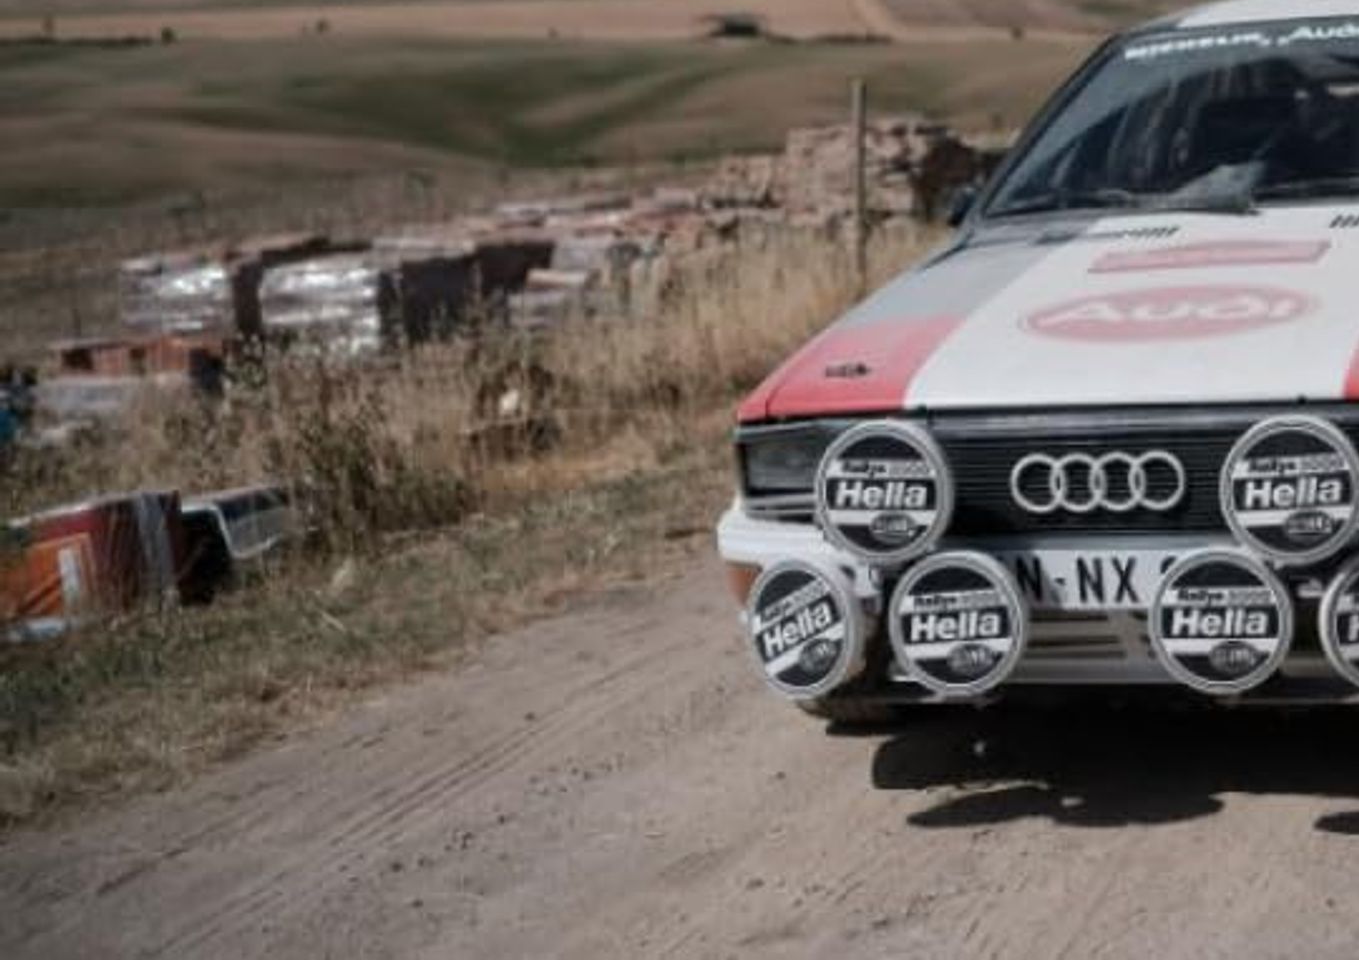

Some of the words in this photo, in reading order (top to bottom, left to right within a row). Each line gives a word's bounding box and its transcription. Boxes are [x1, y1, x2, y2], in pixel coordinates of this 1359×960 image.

[1035, 292, 1298, 327] Audi
[834, 480, 928, 509] Hella
[1244, 476, 1343, 509] Hella
[1014, 555, 1139, 604] N-NX
[762, 600, 832, 659] Hella
[910, 610, 1000, 641] Hella
[1170, 608, 1270, 637] Hella
